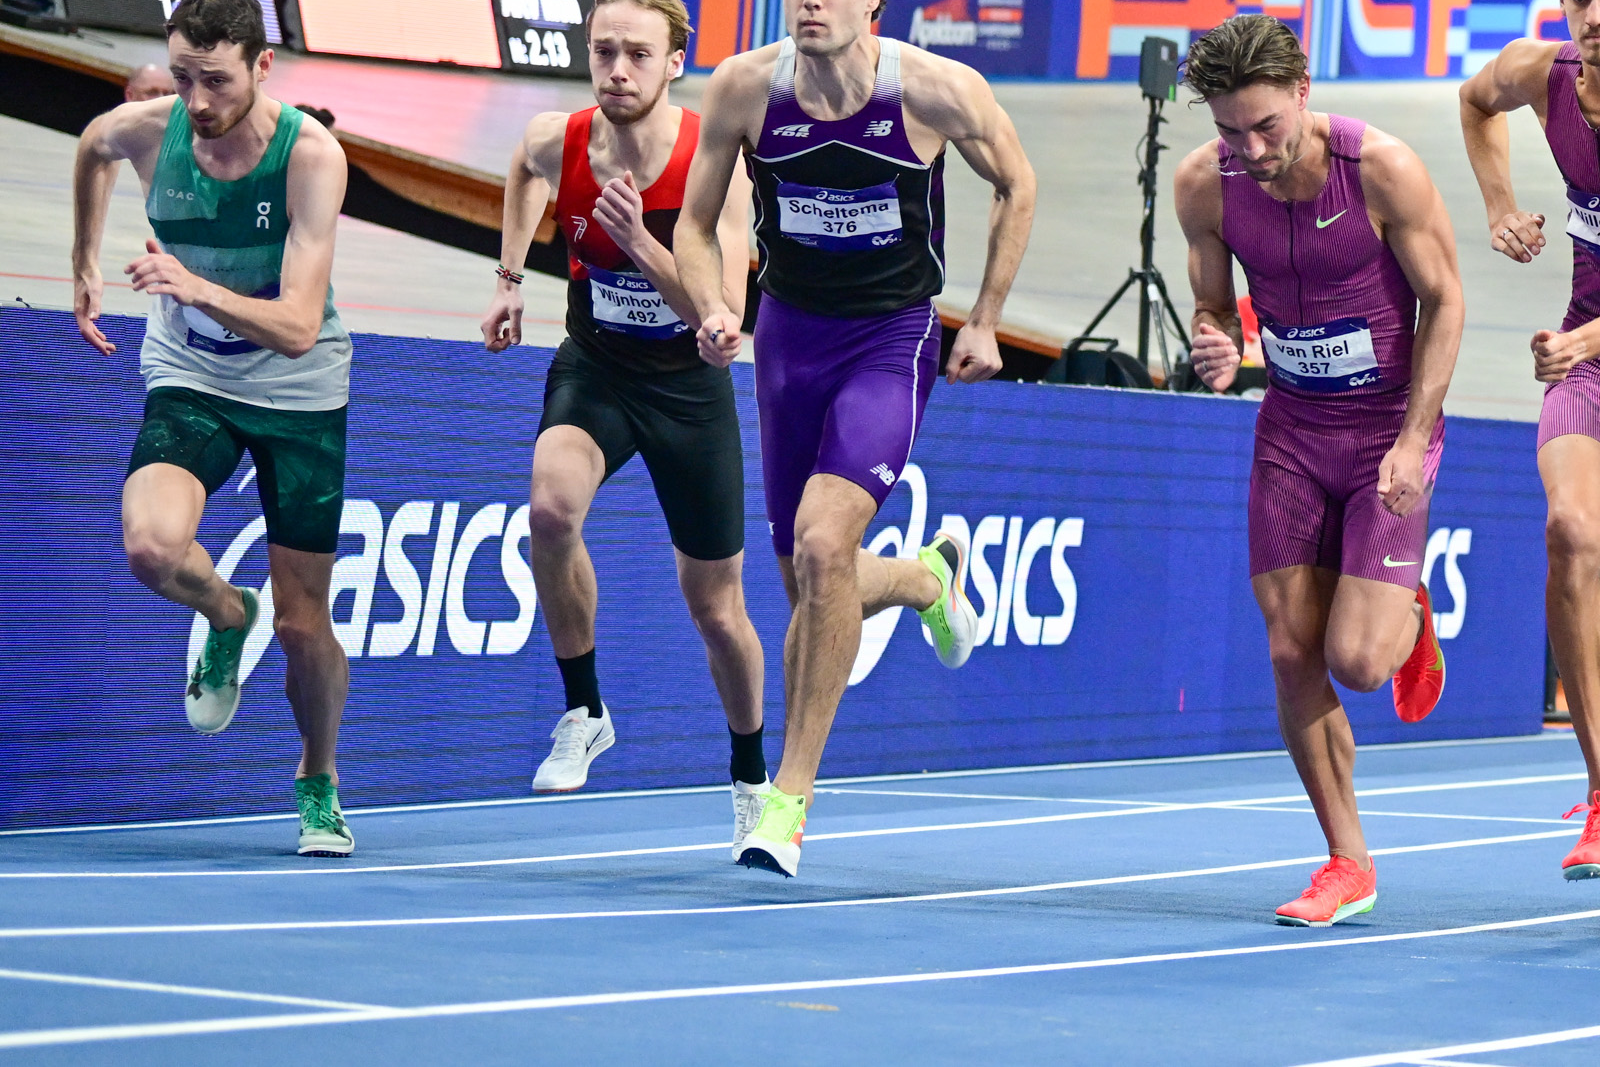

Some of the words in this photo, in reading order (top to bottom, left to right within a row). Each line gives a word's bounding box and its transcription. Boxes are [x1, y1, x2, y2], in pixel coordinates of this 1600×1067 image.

[166, 188, 195, 201] OAC
[789, 199, 889, 219] Scheltema
[822, 220, 857, 234] 376
[627, 310, 658, 324] 492
[1276, 343, 1307, 358] van
[1312, 340, 1349, 359] Riel
[1298, 361, 1331, 374] 357
